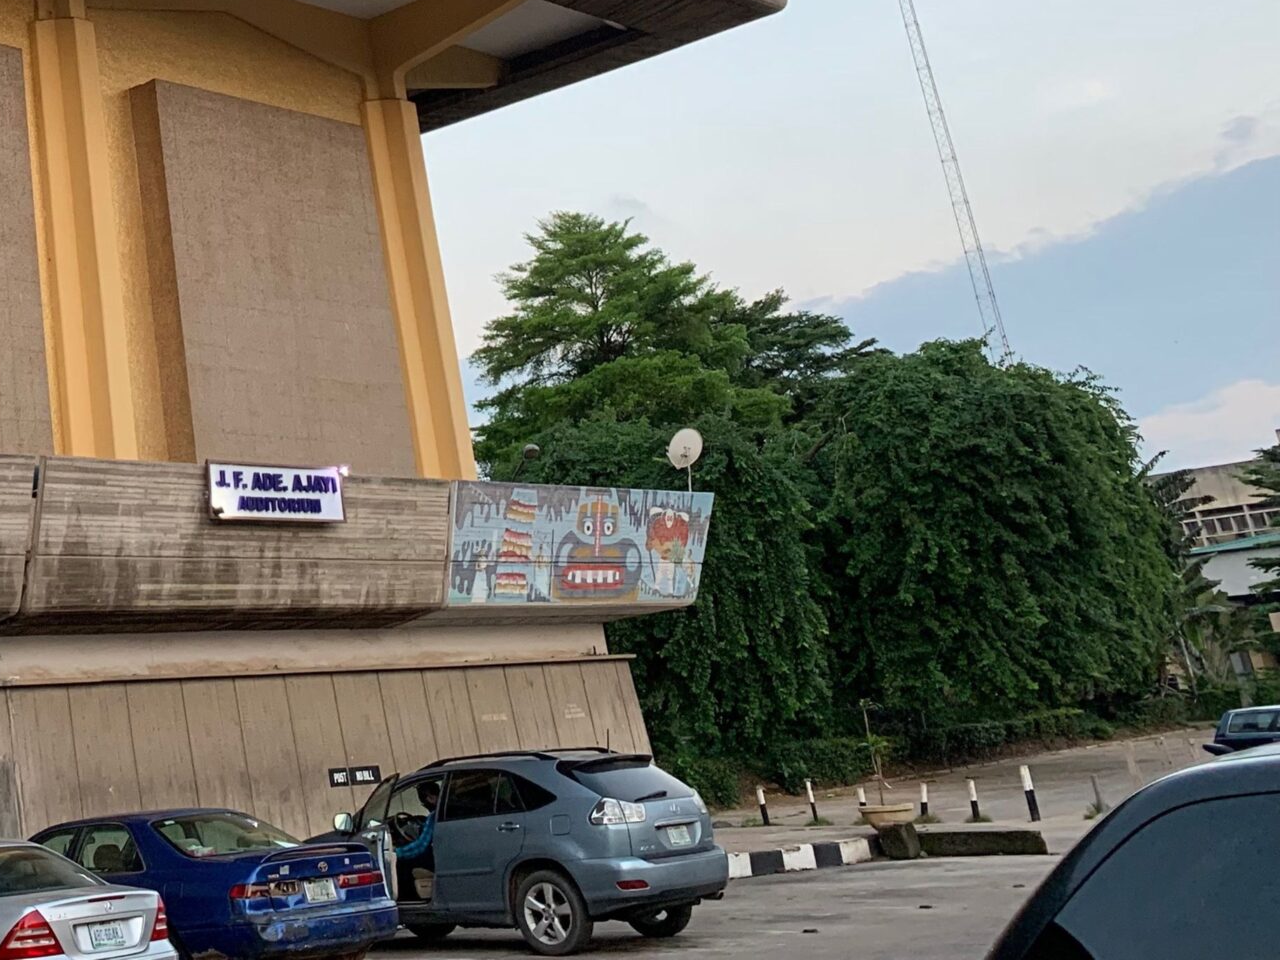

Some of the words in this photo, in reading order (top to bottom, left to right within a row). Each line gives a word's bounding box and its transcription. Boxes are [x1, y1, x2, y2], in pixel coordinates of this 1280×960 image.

[215, 470, 231, 488] J.
[232, 471, 248, 489] F.
[251, 472, 288, 492] ADE.
[291, 474, 337, 494] AJAYI
[237, 496, 322, 514] AUDITORIUM
[333, 772, 347, 783] POST
